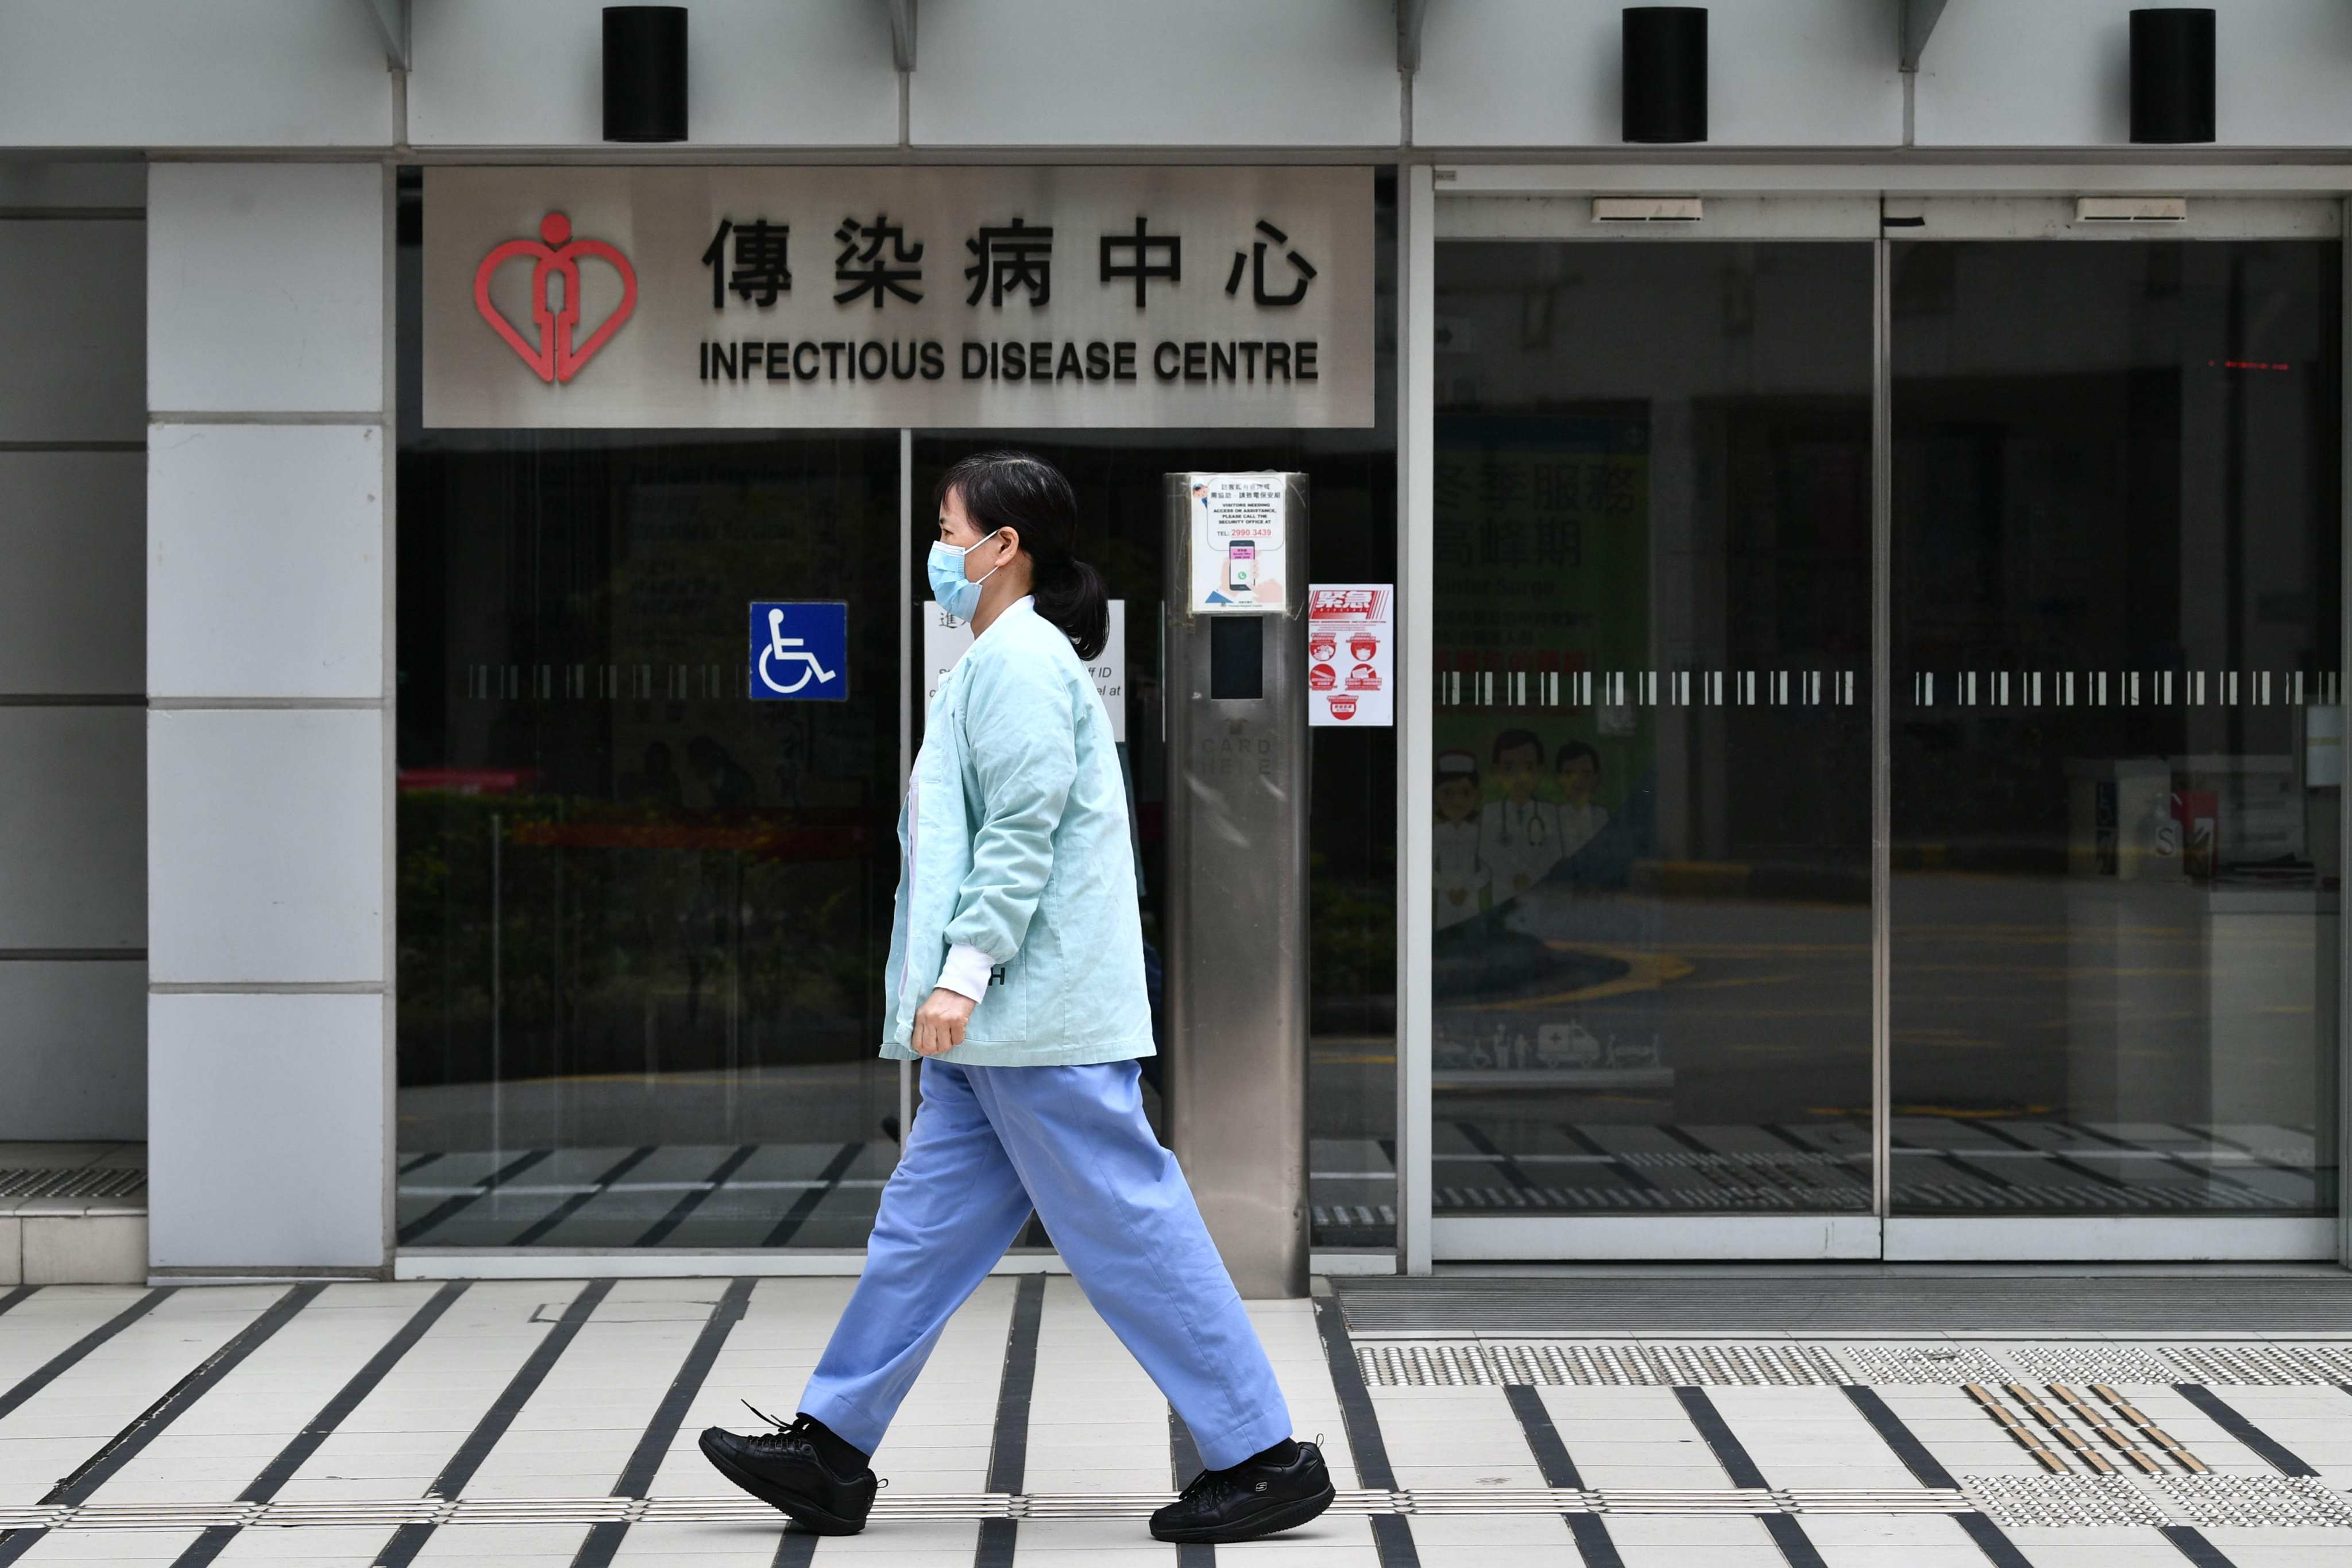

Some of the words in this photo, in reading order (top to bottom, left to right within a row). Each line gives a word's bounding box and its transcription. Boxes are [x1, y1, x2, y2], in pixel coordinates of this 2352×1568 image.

[701, 216, 1318, 309] 傳染病中心
[700, 341, 945, 383] INFECTIOUS
[961, 341, 1137, 383] DISEASE
[1153, 341, 1318, 383] CENTRE
[1098, 667, 1112, 678] ID
[1109, 685, 1121, 696] at
[1201, 737, 1271, 755] CARD
